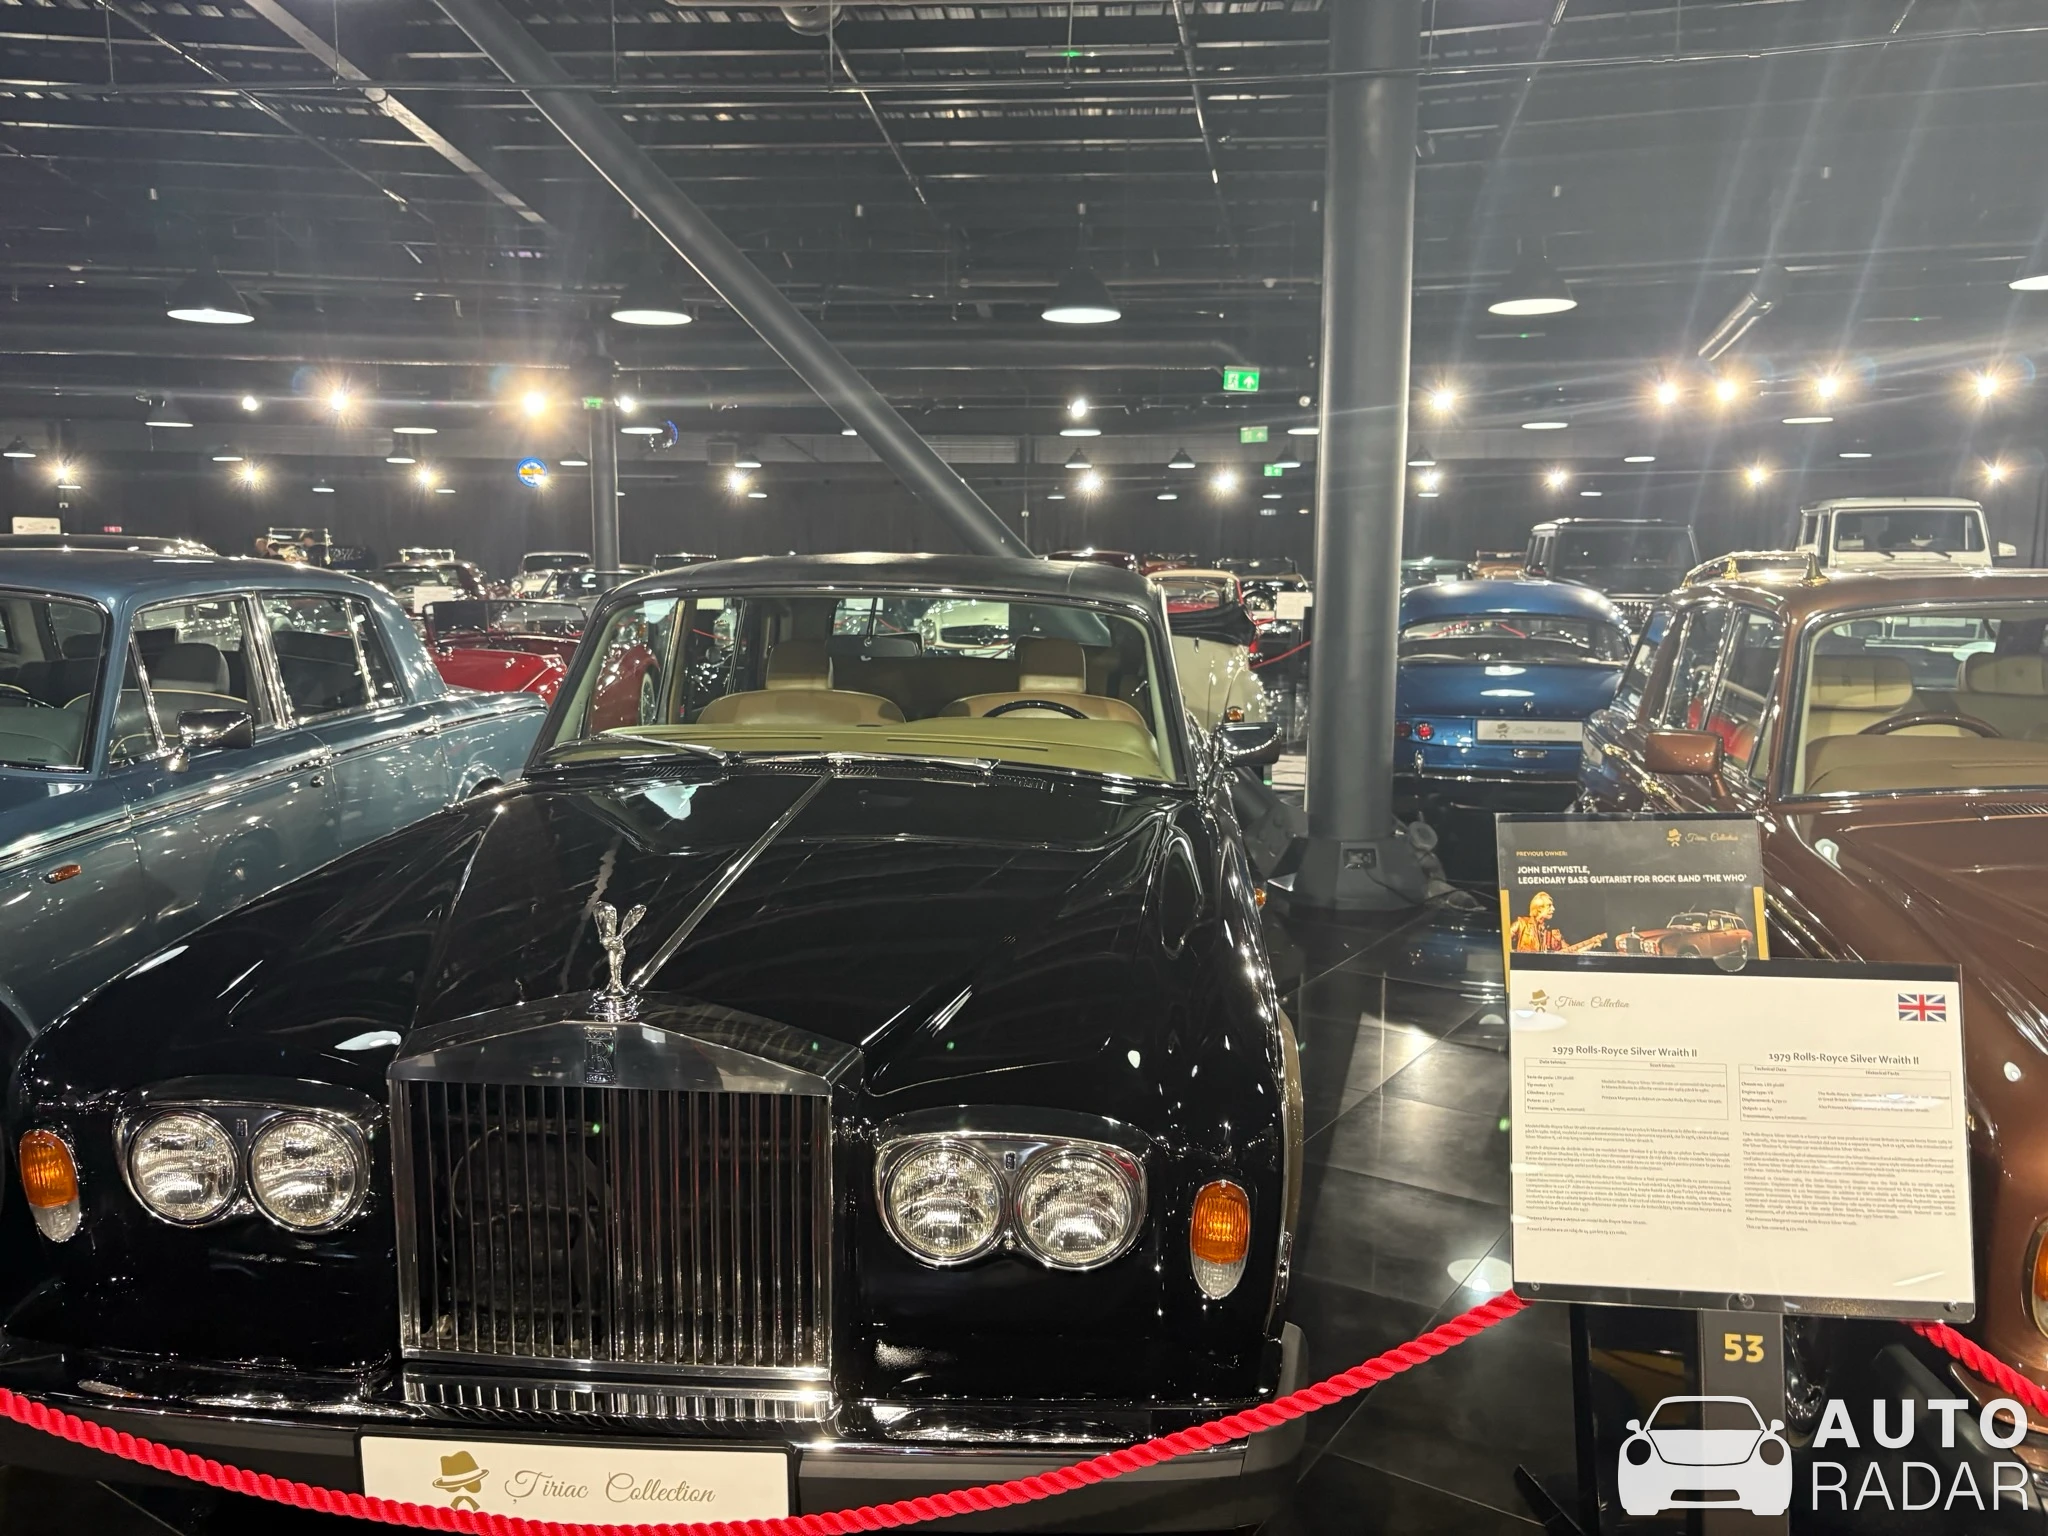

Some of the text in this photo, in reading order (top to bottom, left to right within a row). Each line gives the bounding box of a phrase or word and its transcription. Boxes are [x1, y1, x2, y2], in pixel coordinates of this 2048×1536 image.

[1517, 866, 1591, 875] JOHN ENTWISTLE,
[1518, 876, 1566, 884] LEGENDARY
[1568, 876, 1588, 884] BASS
[1590, 875, 1632, 884] GUITARIST
[1633, 875, 1651, 883] FOR
[1652, 875, 1677, 883] ROCK
[1677, 874, 1701, 883] BAND
[1590, 996, 1630, 1009] Collection
[1552, 1045, 1698, 1057] 1979 Rolls-Royce Silver Wraith II
[1768, 1052, 1920, 1065] 1979 Rolls-Royce Silver Wraith II
[1723, 1333, 1765, 1364] 53
[605, 1471, 716, 1503] Collection
